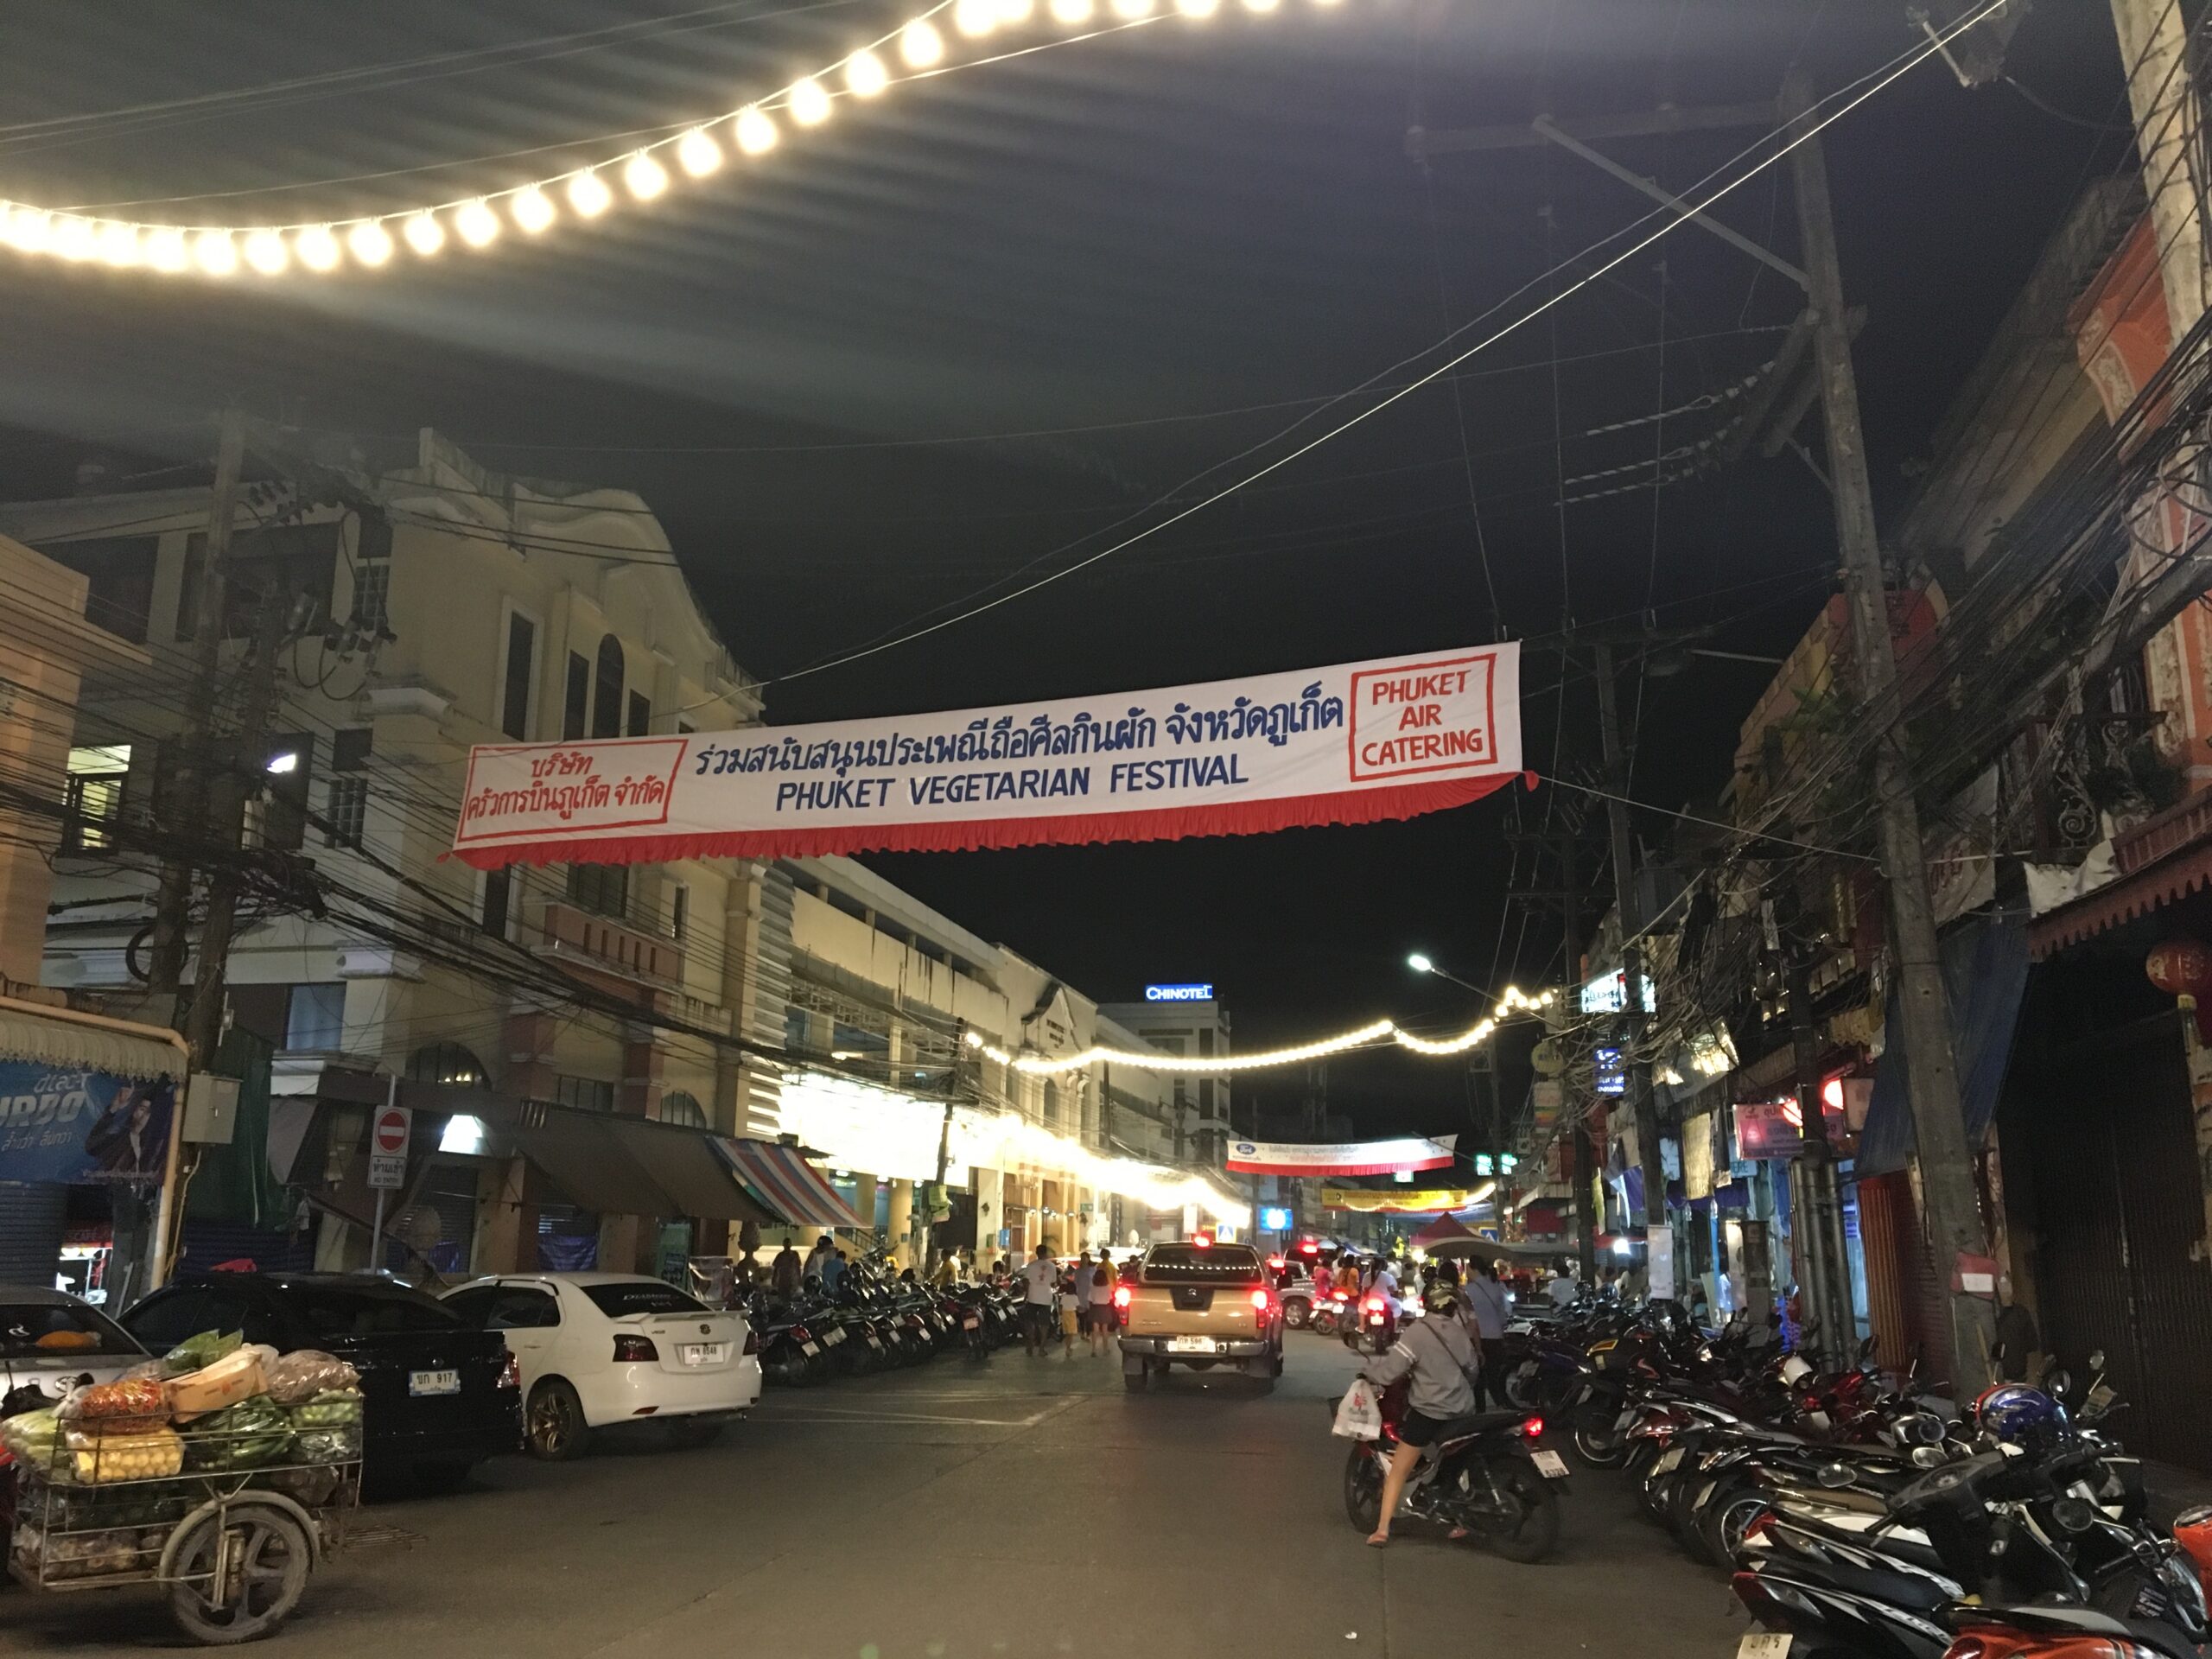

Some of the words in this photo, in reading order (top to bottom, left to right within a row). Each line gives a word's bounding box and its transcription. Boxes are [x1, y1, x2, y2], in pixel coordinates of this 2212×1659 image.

[1372, 671, 1471, 705] PHUKET
[696, 708, 1156, 778] ร่วมสนับสนุนประเพณีถือศีลกินผัก
[1165, 681, 1343, 744] จังหวัดภูเก็ต
[1397, 704, 1442, 731] AIR
[1362, 728, 1484, 766] CATERING
[531, 751, 594, 778] บริษัท
[467, 774, 610, 820] ครัวการบินภูเก็ต
[614, 774, 665, 807] จำกัด
[777, 779, 895, 810] PHUKET
[911, 767, 1090, 804] VEGETARIAN
[1110, 754, 1249, 792] FESTIVAL
[1146, 985, 1212, 1000] CHINOTEL
[436, 1372, 453, 1383] 917
